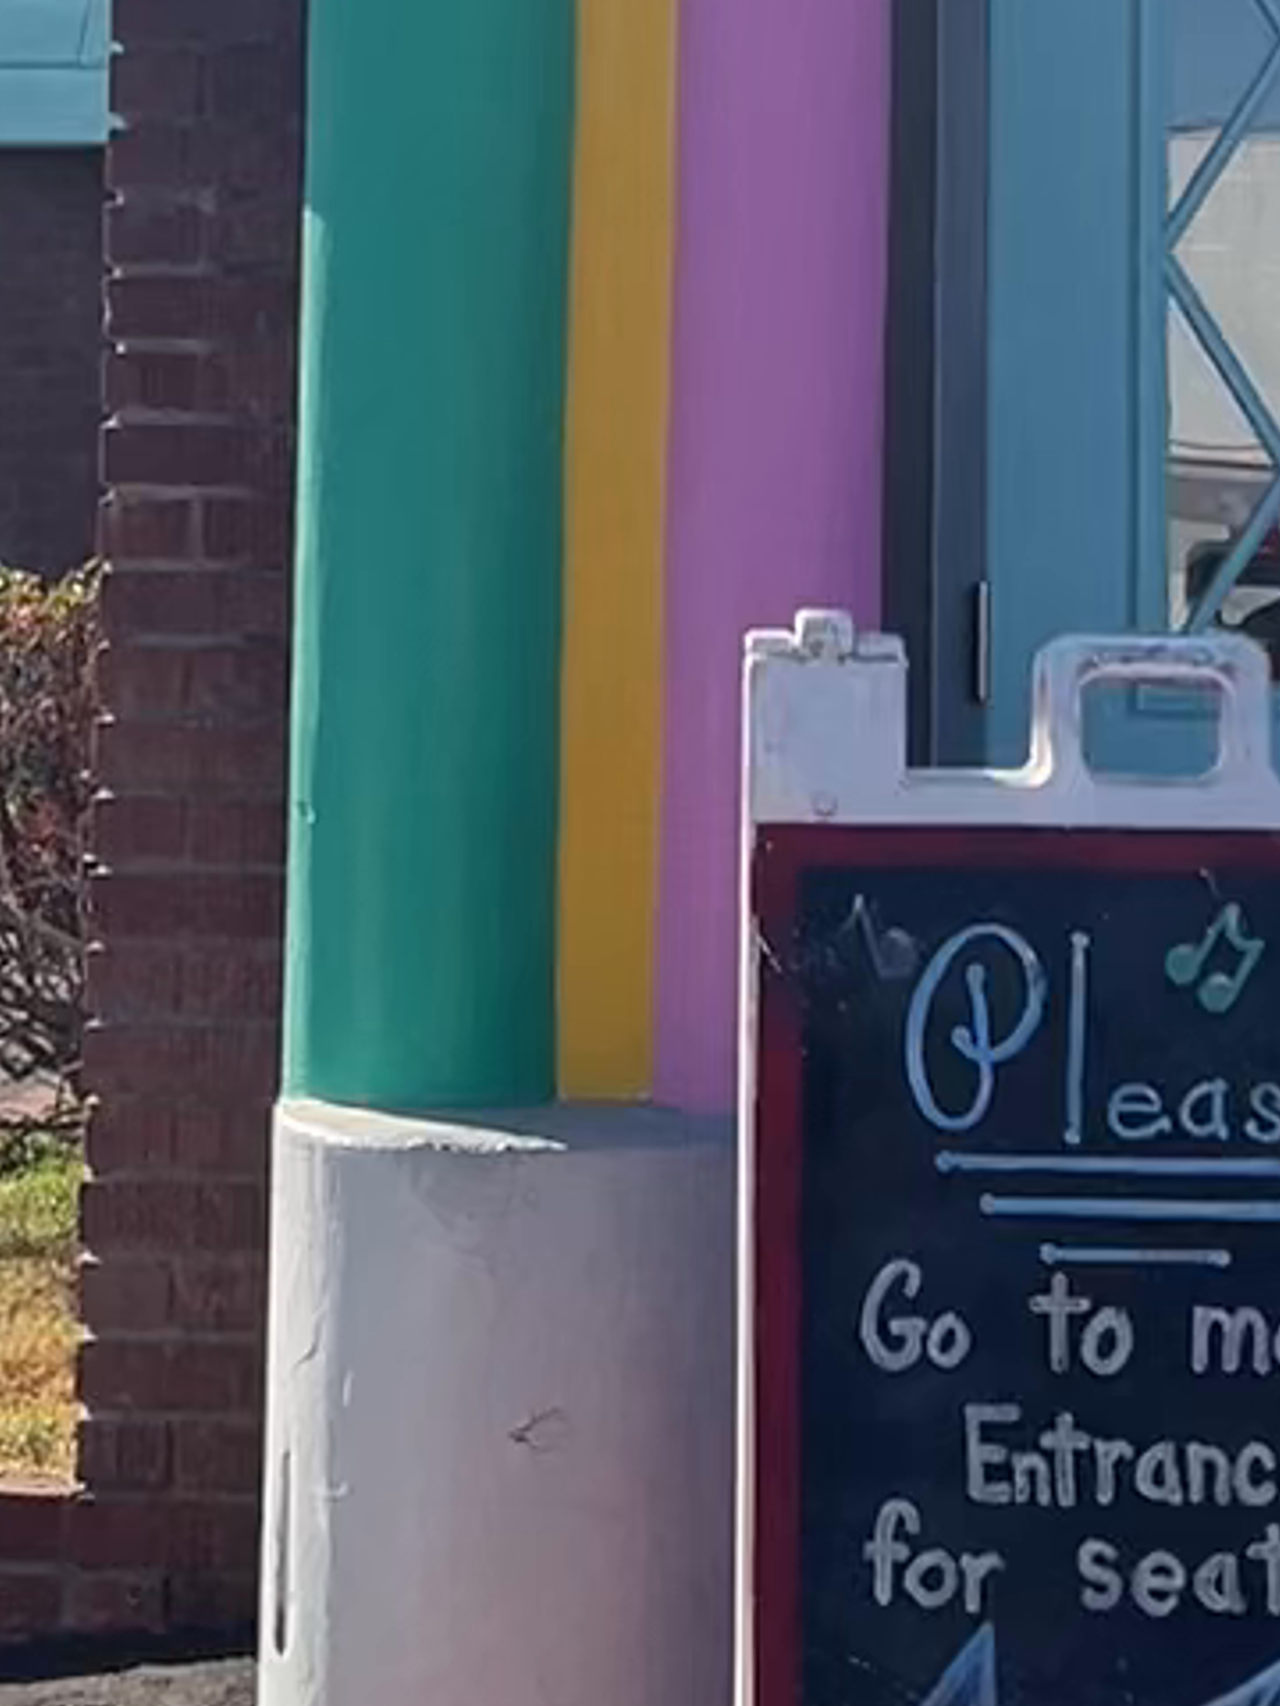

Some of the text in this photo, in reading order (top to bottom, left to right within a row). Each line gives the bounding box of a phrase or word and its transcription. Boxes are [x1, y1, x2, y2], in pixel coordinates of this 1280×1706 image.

[859, 1259, 972, 1373] Go
[1028, 1271, 1135, 1376] to
[863, 1497, 1007, 1615] for
